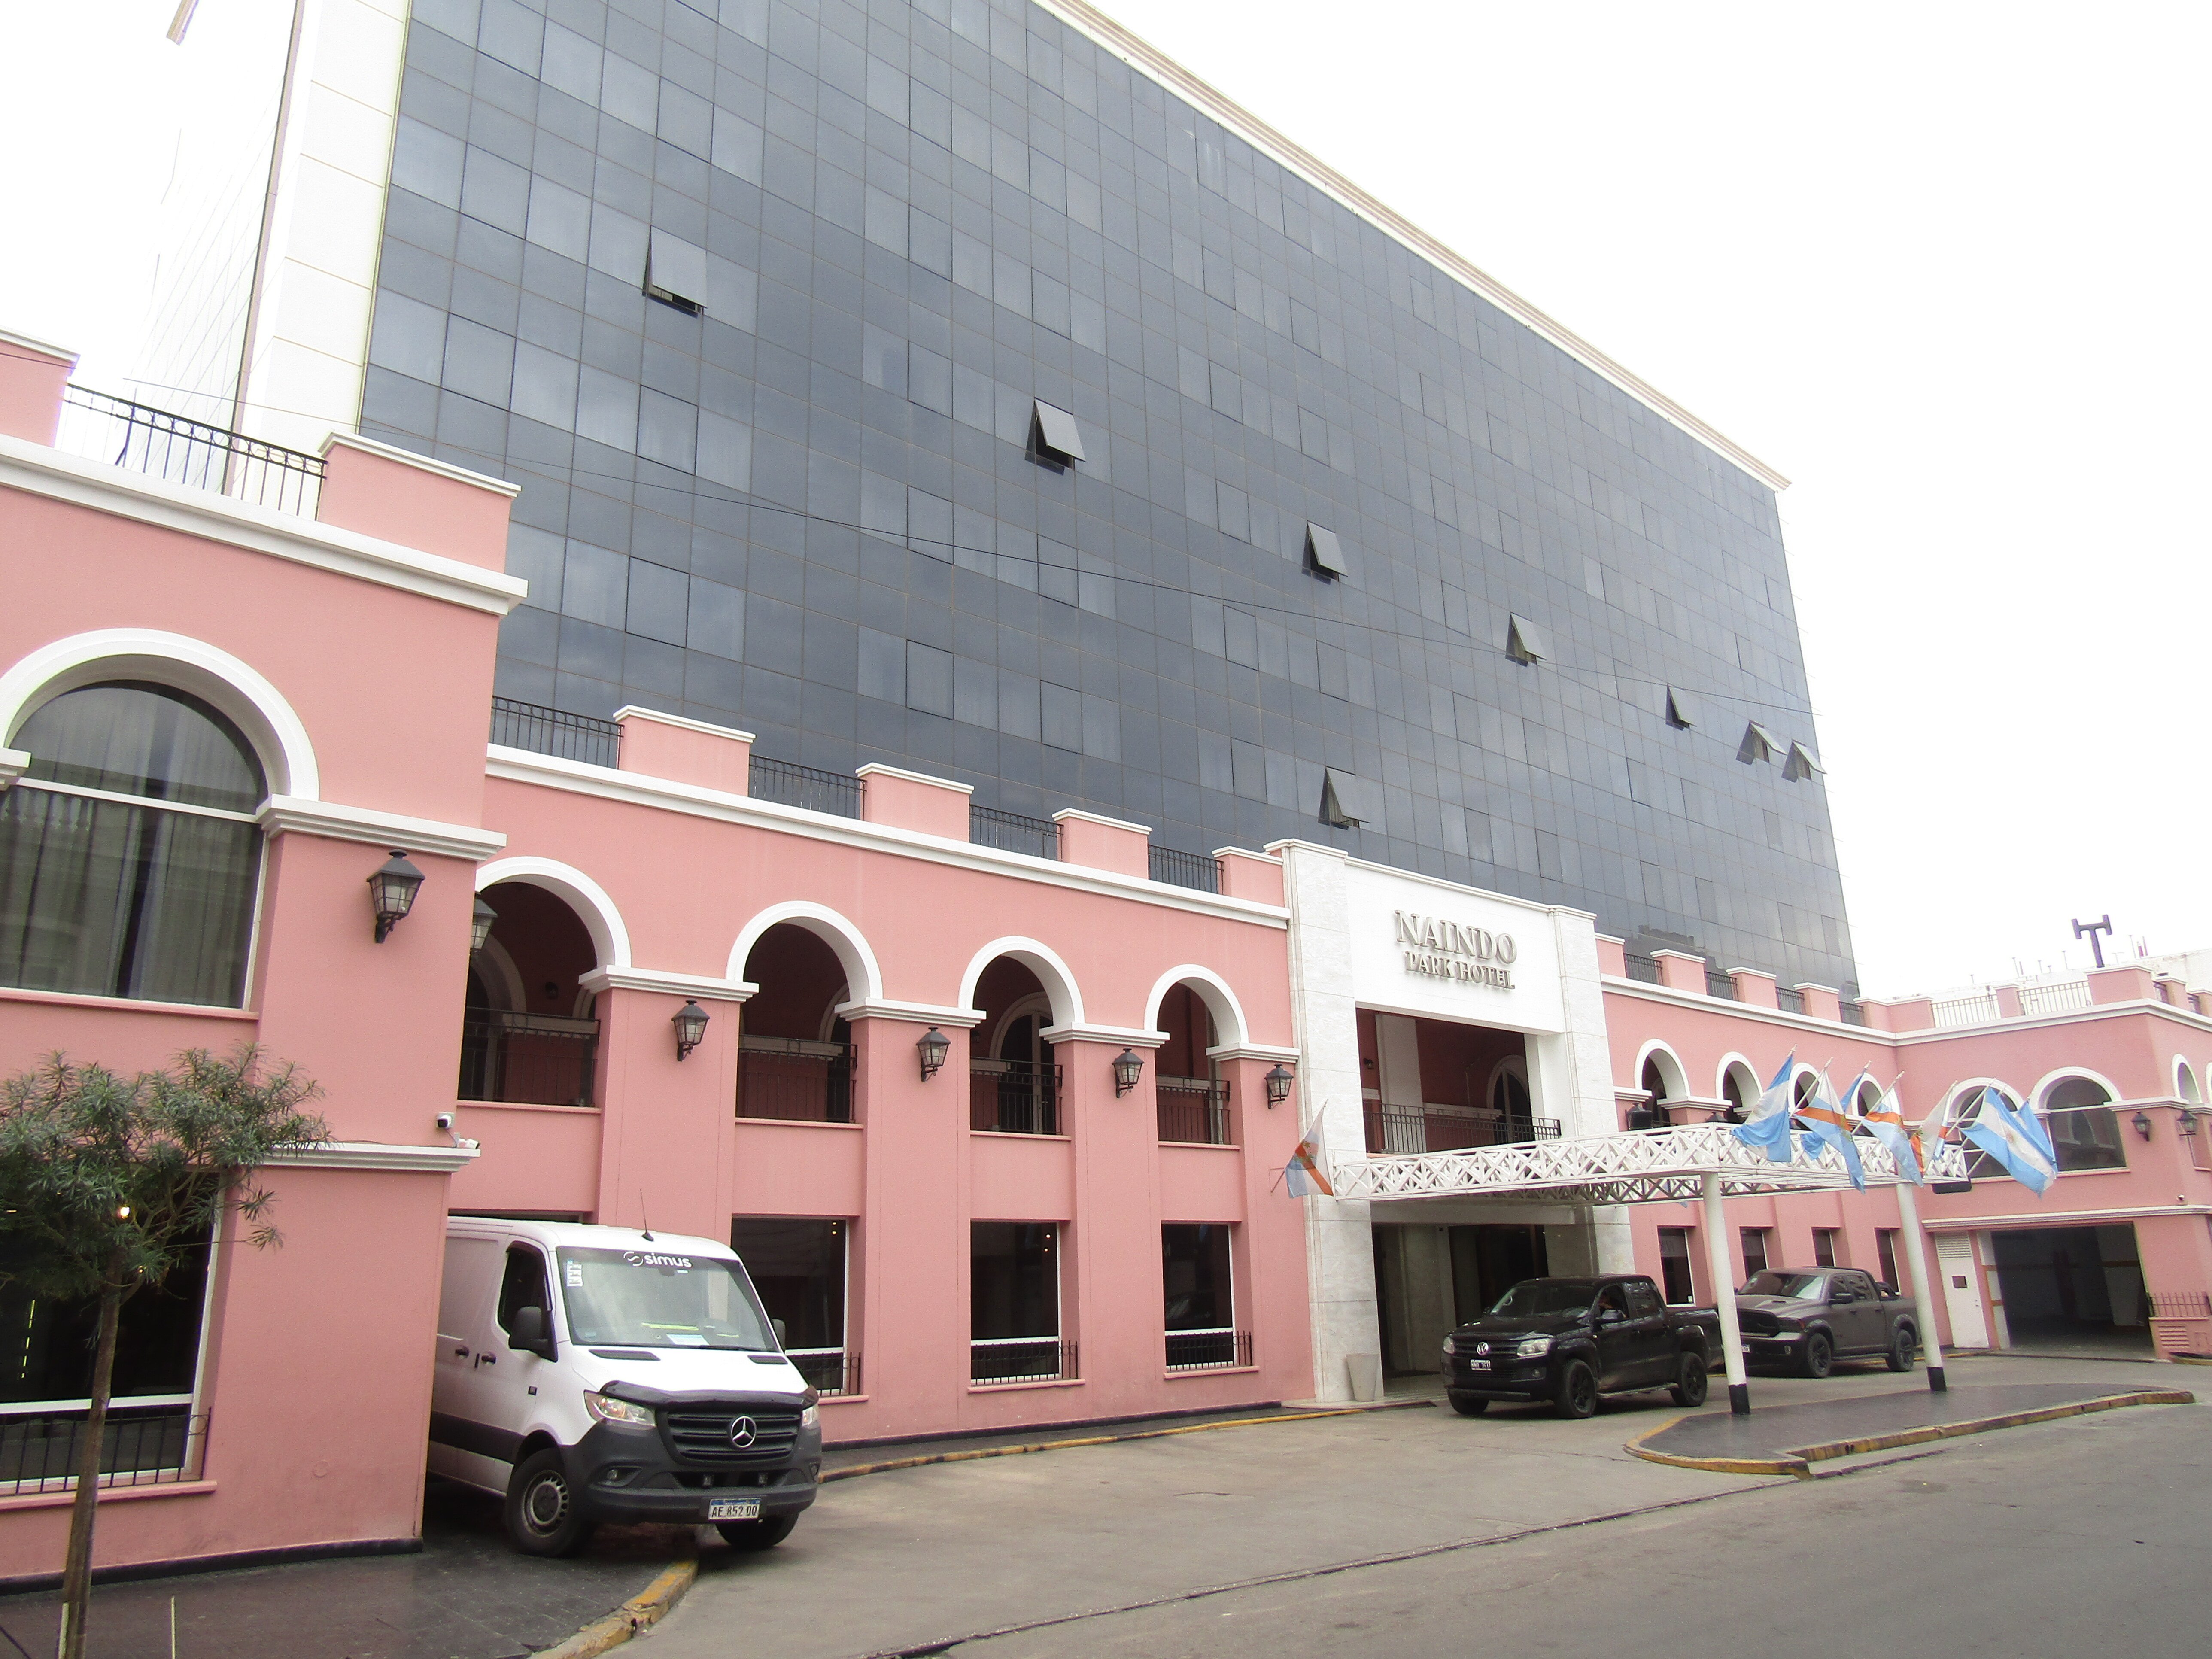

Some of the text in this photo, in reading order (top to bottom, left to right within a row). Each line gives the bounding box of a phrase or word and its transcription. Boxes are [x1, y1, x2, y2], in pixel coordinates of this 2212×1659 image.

[1394, 909, 1517, 964] NAINDO
[1404, 951, 1516, 989] PARK HOTEL
[644, 1252, 692, 1267] simus
[711, 1506, 724, 1517] AE
[726, 1505, 744, 1516] 852
